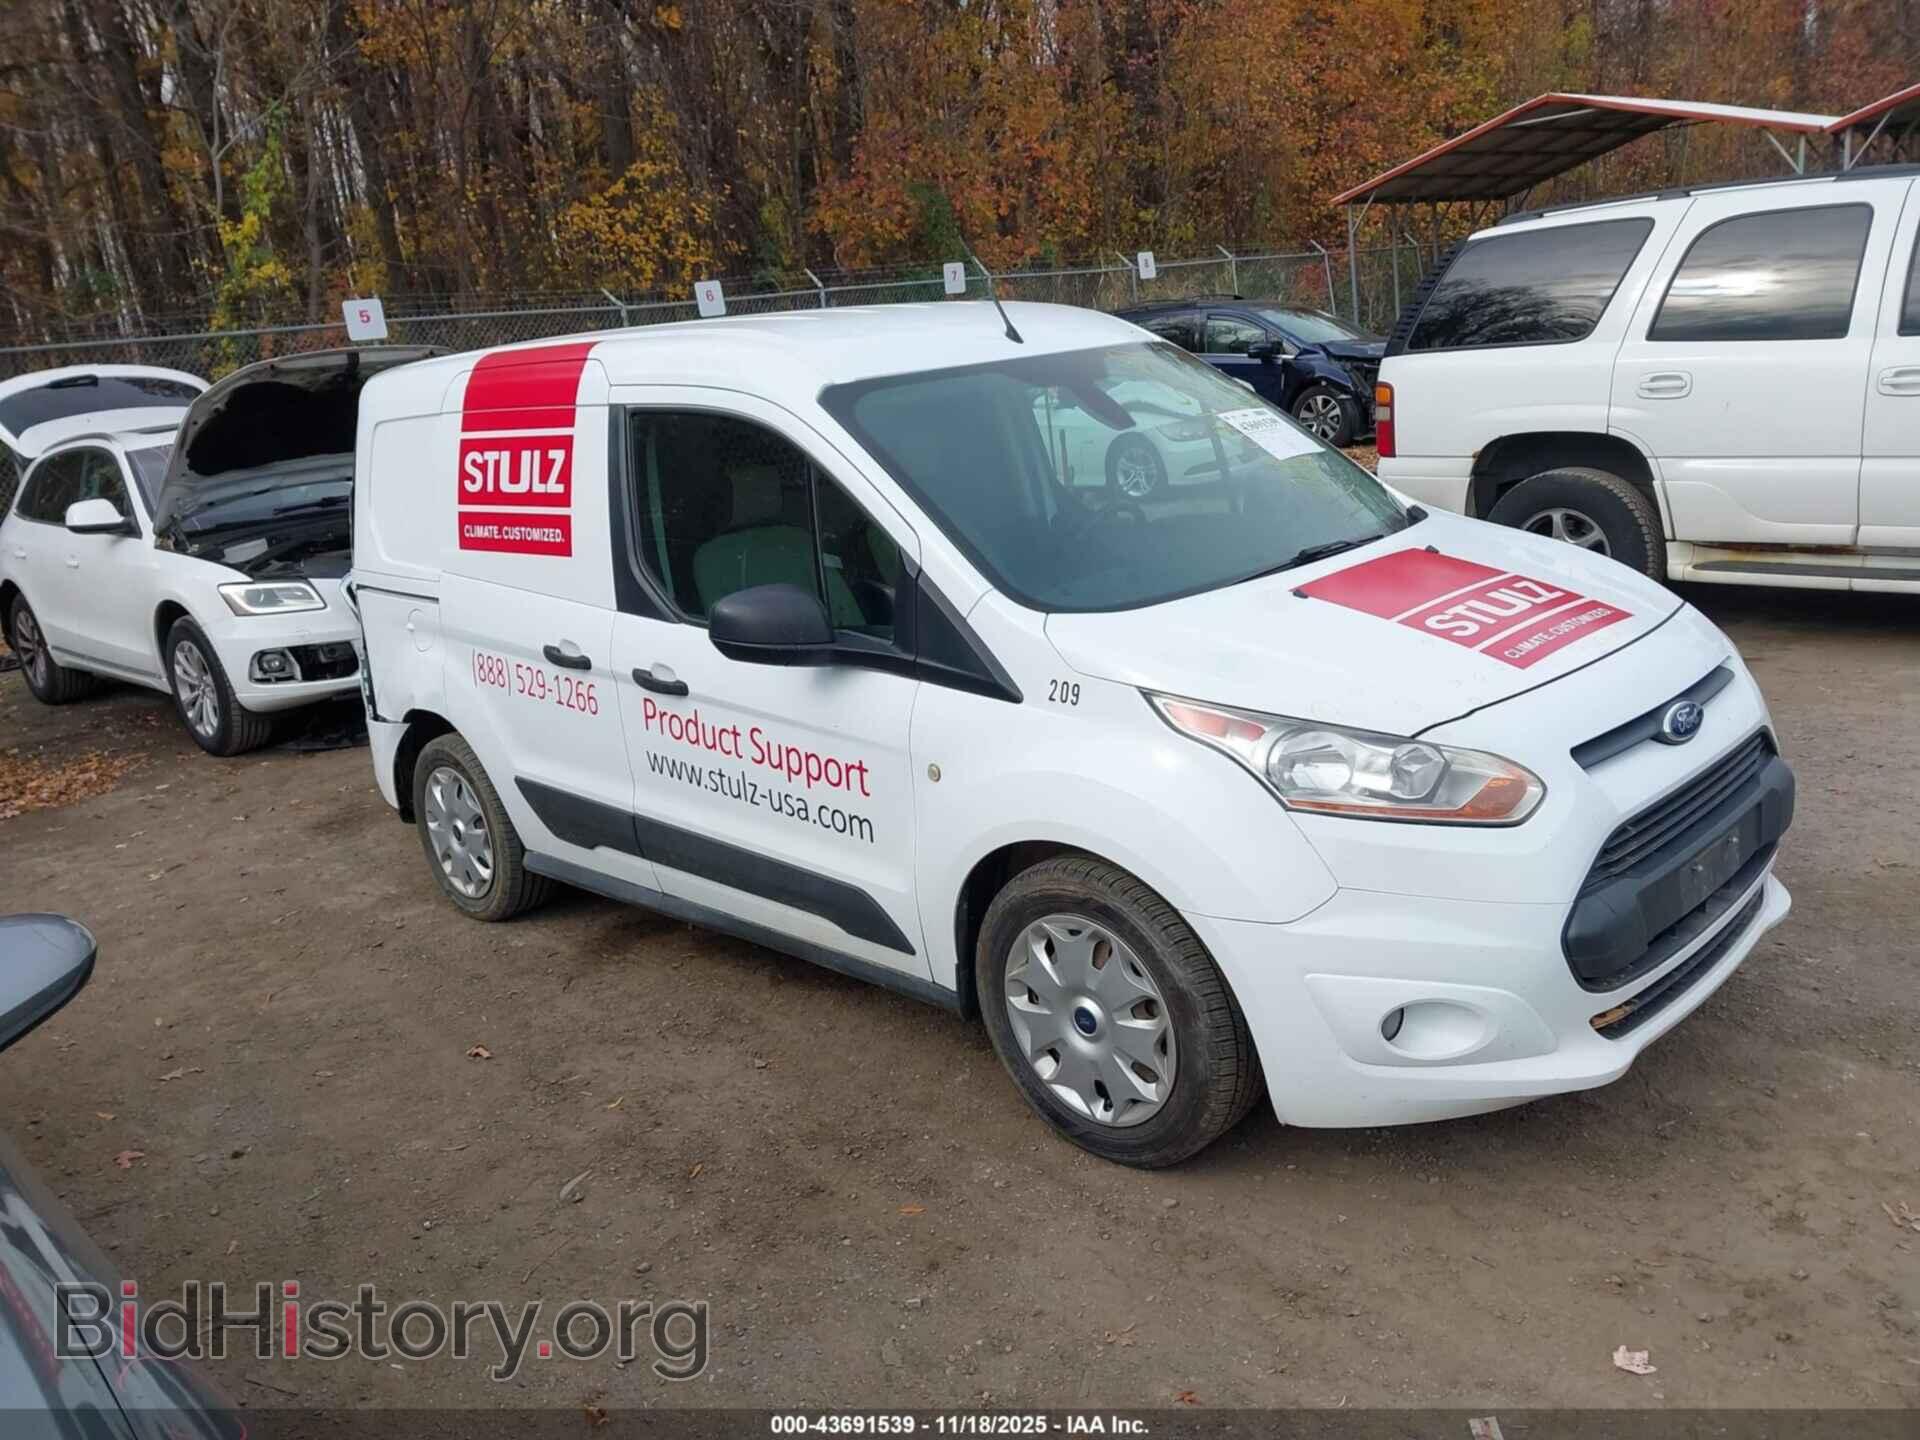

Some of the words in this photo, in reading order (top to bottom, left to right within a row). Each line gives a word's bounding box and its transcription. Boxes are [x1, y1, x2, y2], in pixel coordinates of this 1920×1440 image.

[359, 309, 371, 324] 5
[706, 289, 714, 302] 6
[464, 449, 566, 494] STULZ
[464, 524, 501, 540] CLIMATE.
[502, 526, 565, 543] CUSTOMIZED.
[1424, 580, 1567, 637] STULZ
[1504, 631, 1554, 660] CLIMATE.
[1549, 607, 1616, 638] CUSTOMIZED.
[472, 648, 512, 697] (888)
[515, 663, 599, 716] 529-1266
[1048, 679, 1080, 706] 209
[643, 697, 743, 759] Product
[749, 727, 871, 797] Support
[646, 750, 874, 843] www.stulz-usa.com
